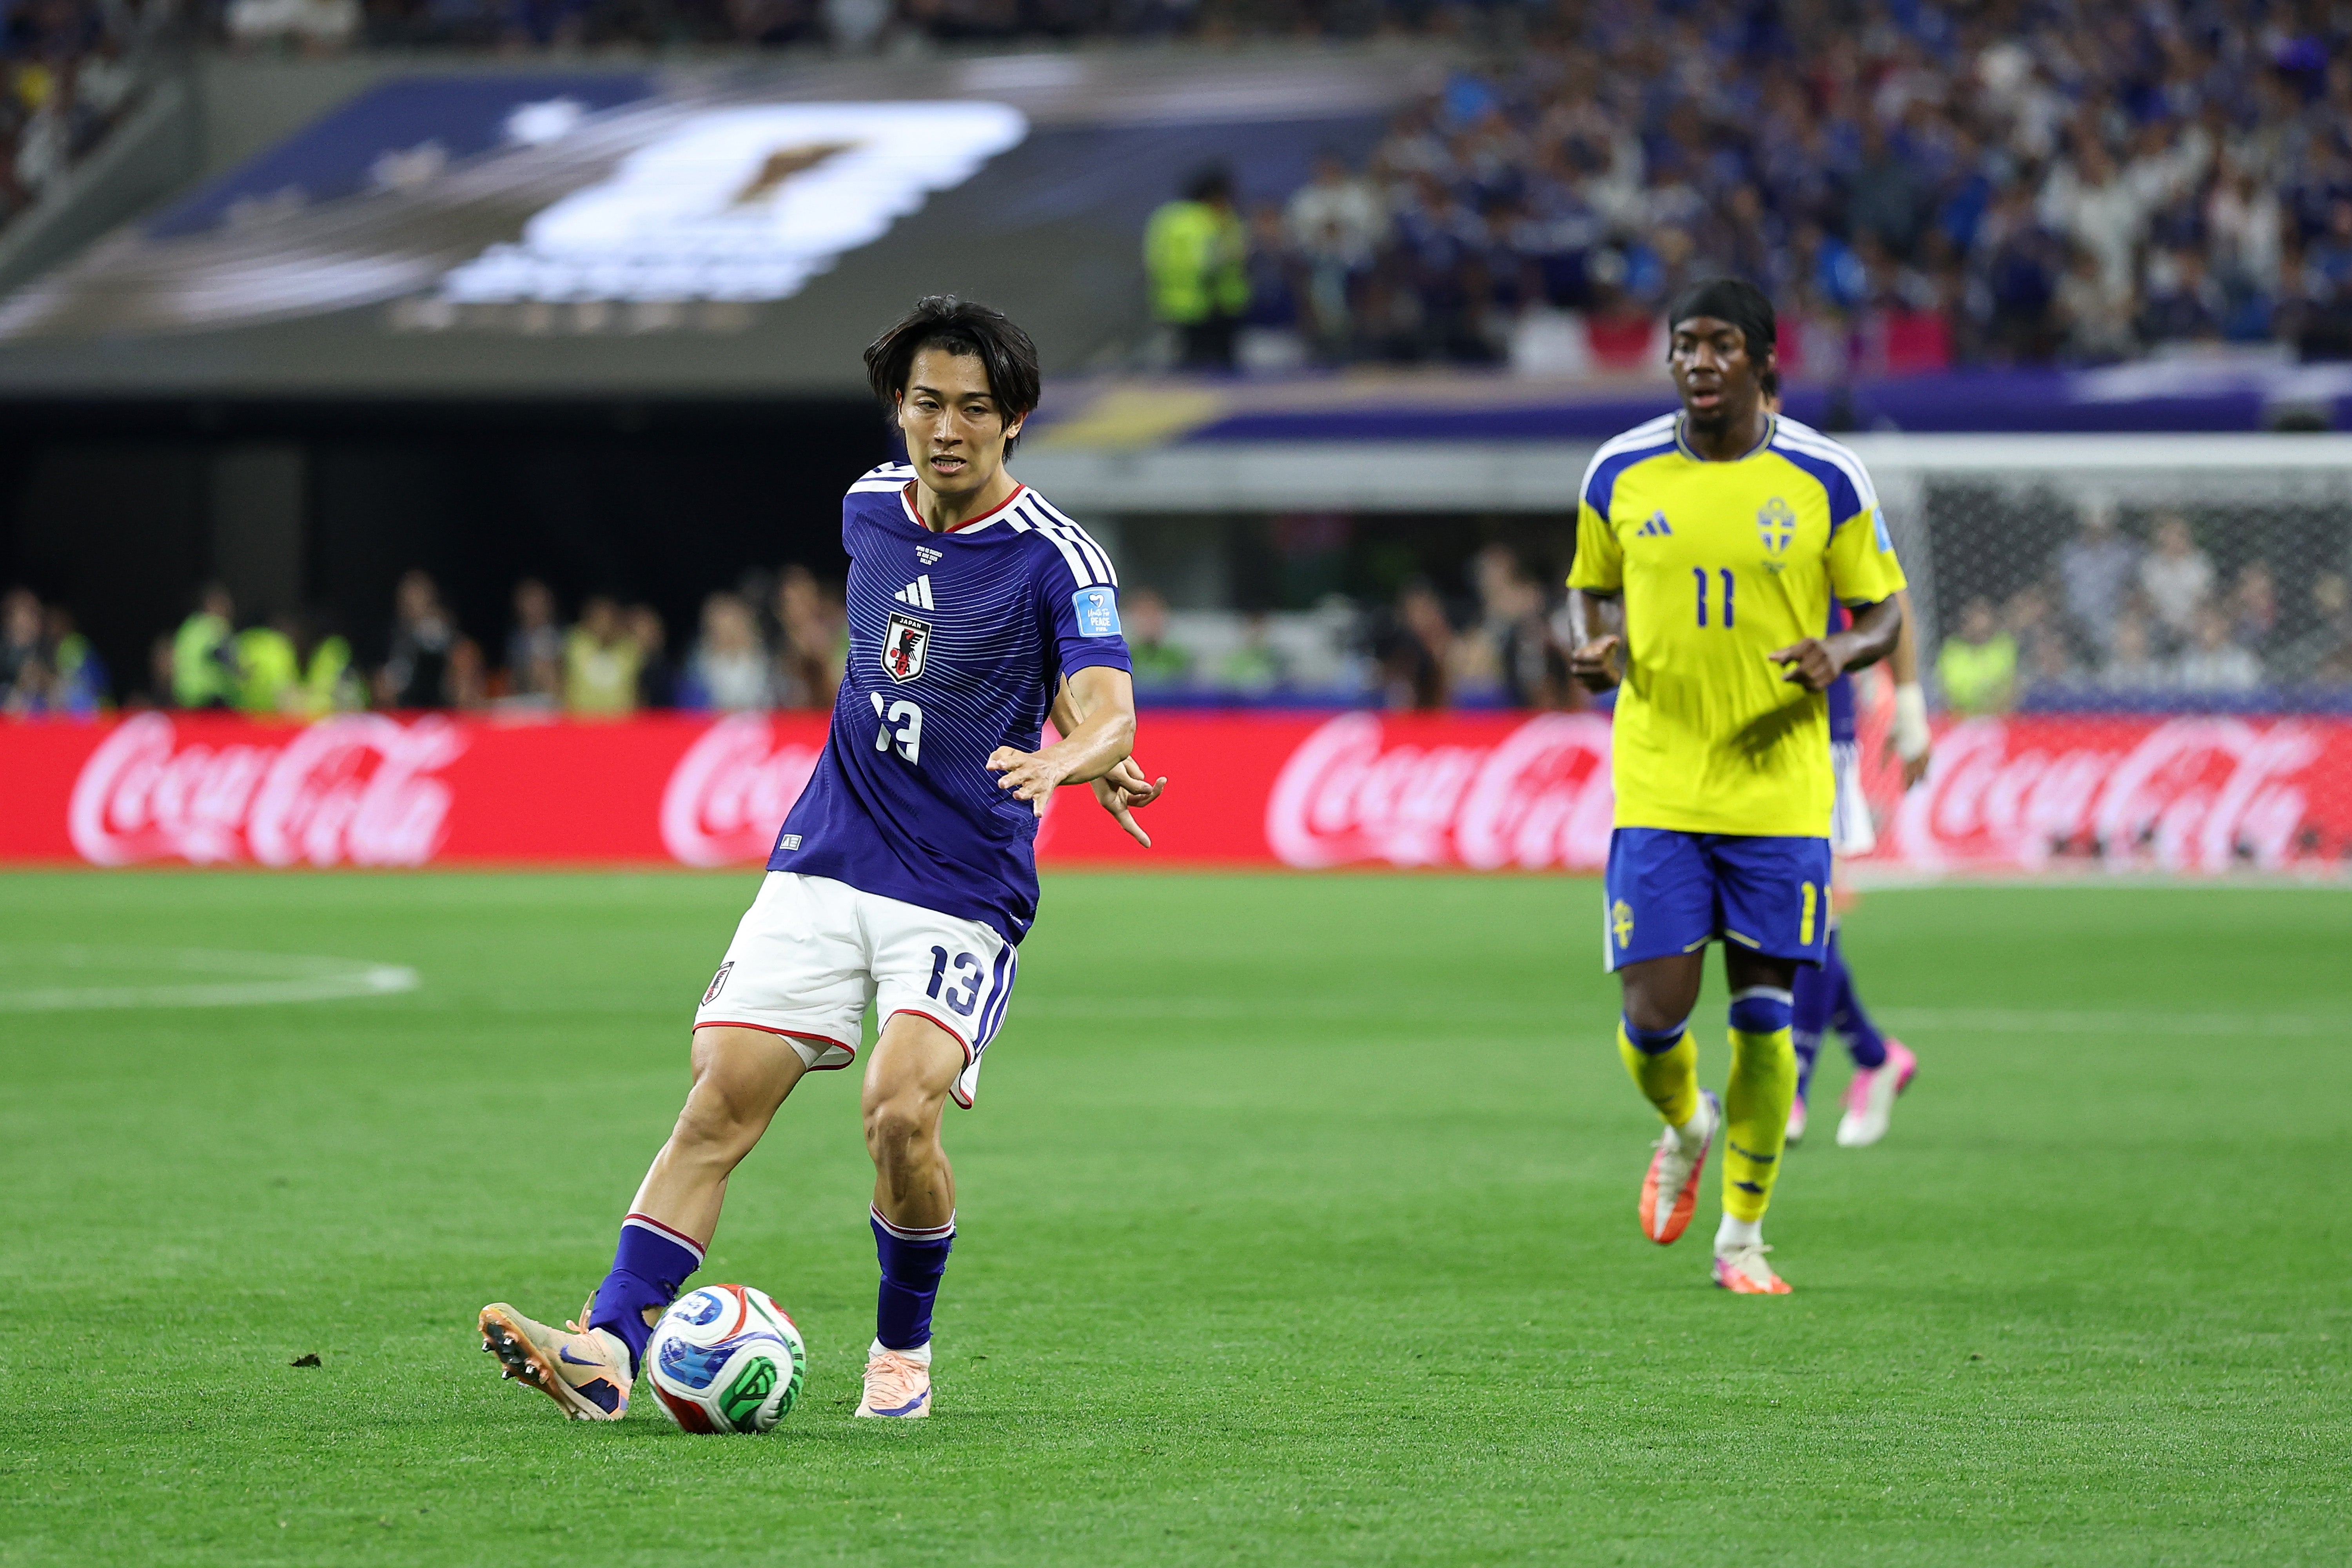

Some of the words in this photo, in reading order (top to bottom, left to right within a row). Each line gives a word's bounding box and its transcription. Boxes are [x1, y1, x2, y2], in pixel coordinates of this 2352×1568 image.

[899, 617, 922, 629] JAPAN
[1090, 617, 1111, 626] PEACE
[1692, 567, 1733, 627] 11
[870, 691, 922, 766] 13
[926, 945, 985, 1017] 13
